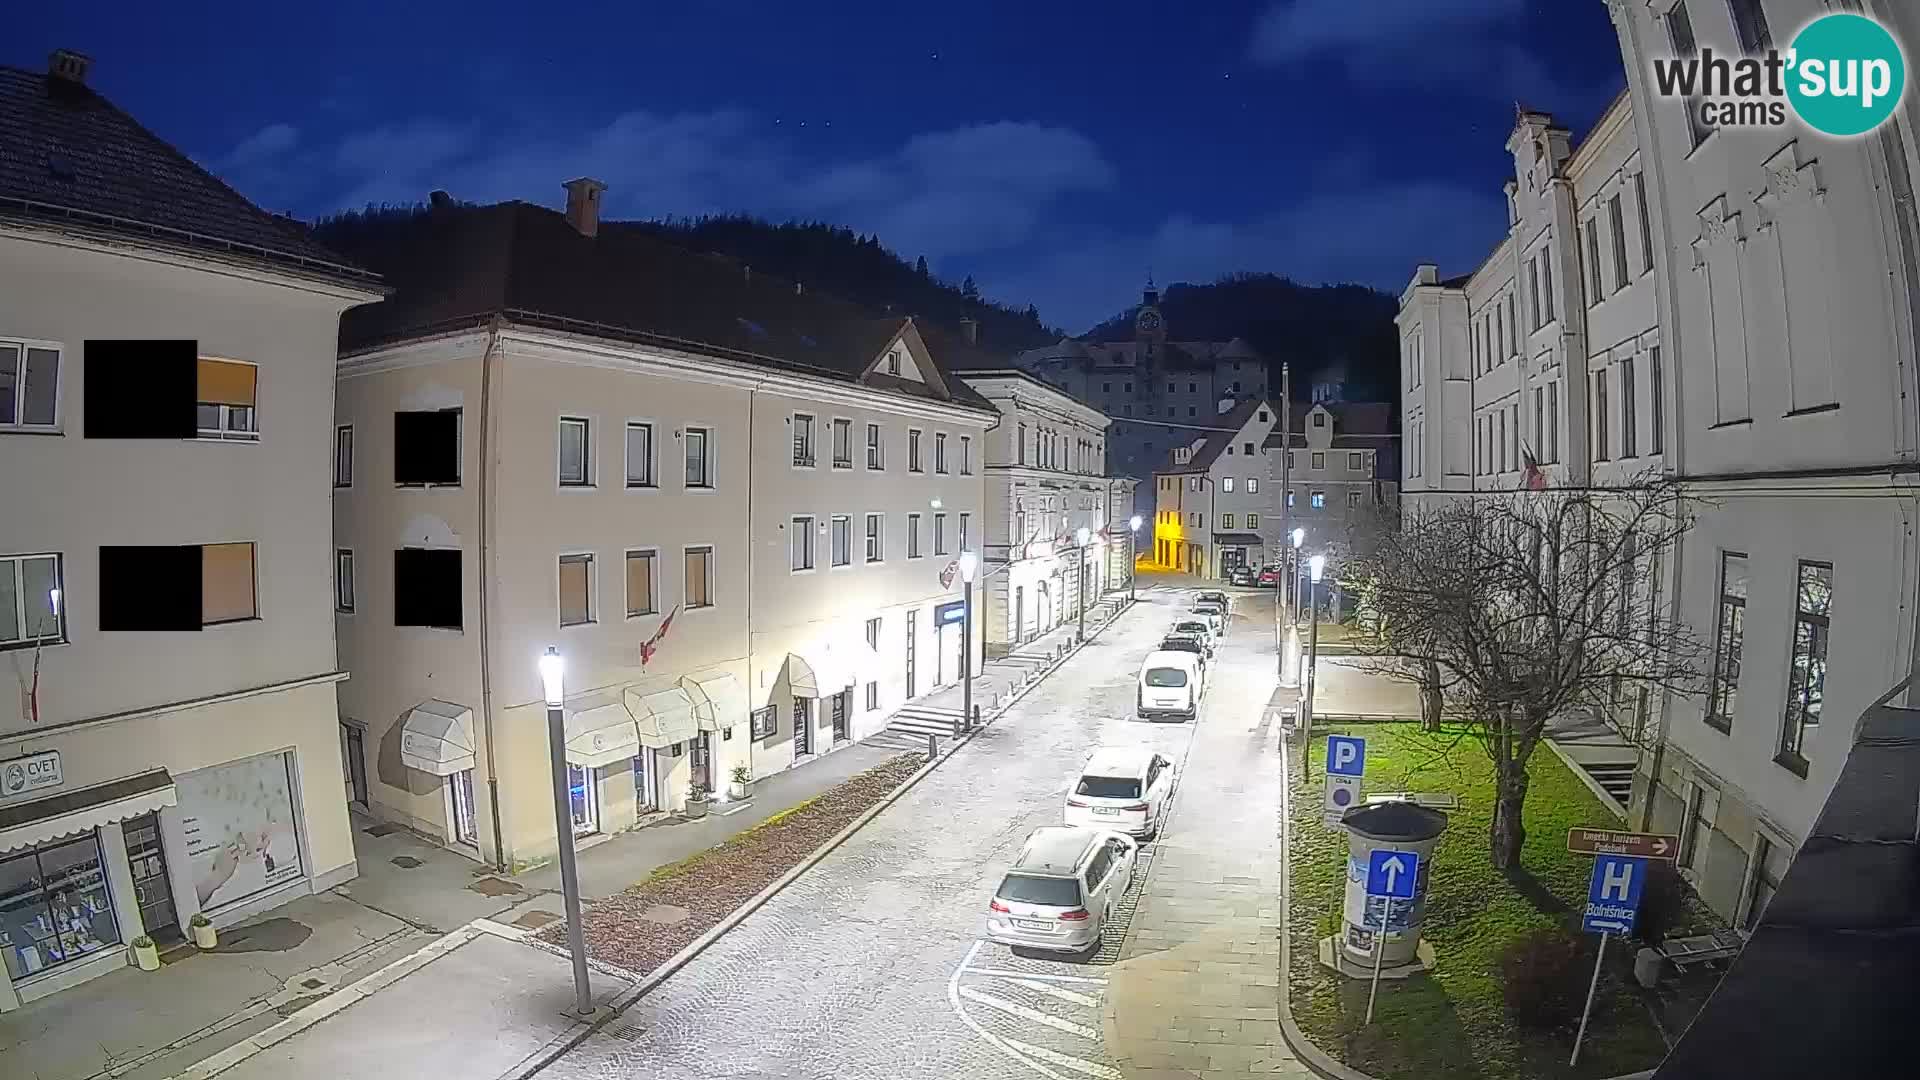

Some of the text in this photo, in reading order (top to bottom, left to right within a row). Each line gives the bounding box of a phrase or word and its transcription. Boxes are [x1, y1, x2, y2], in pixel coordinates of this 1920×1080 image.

[28, 758, 57, 775] CVET
[1335, 741, 1356, 770] P
[1600, 862, 1633, 901] H
[1586, 902, 1634, 920] Bolnišnica
